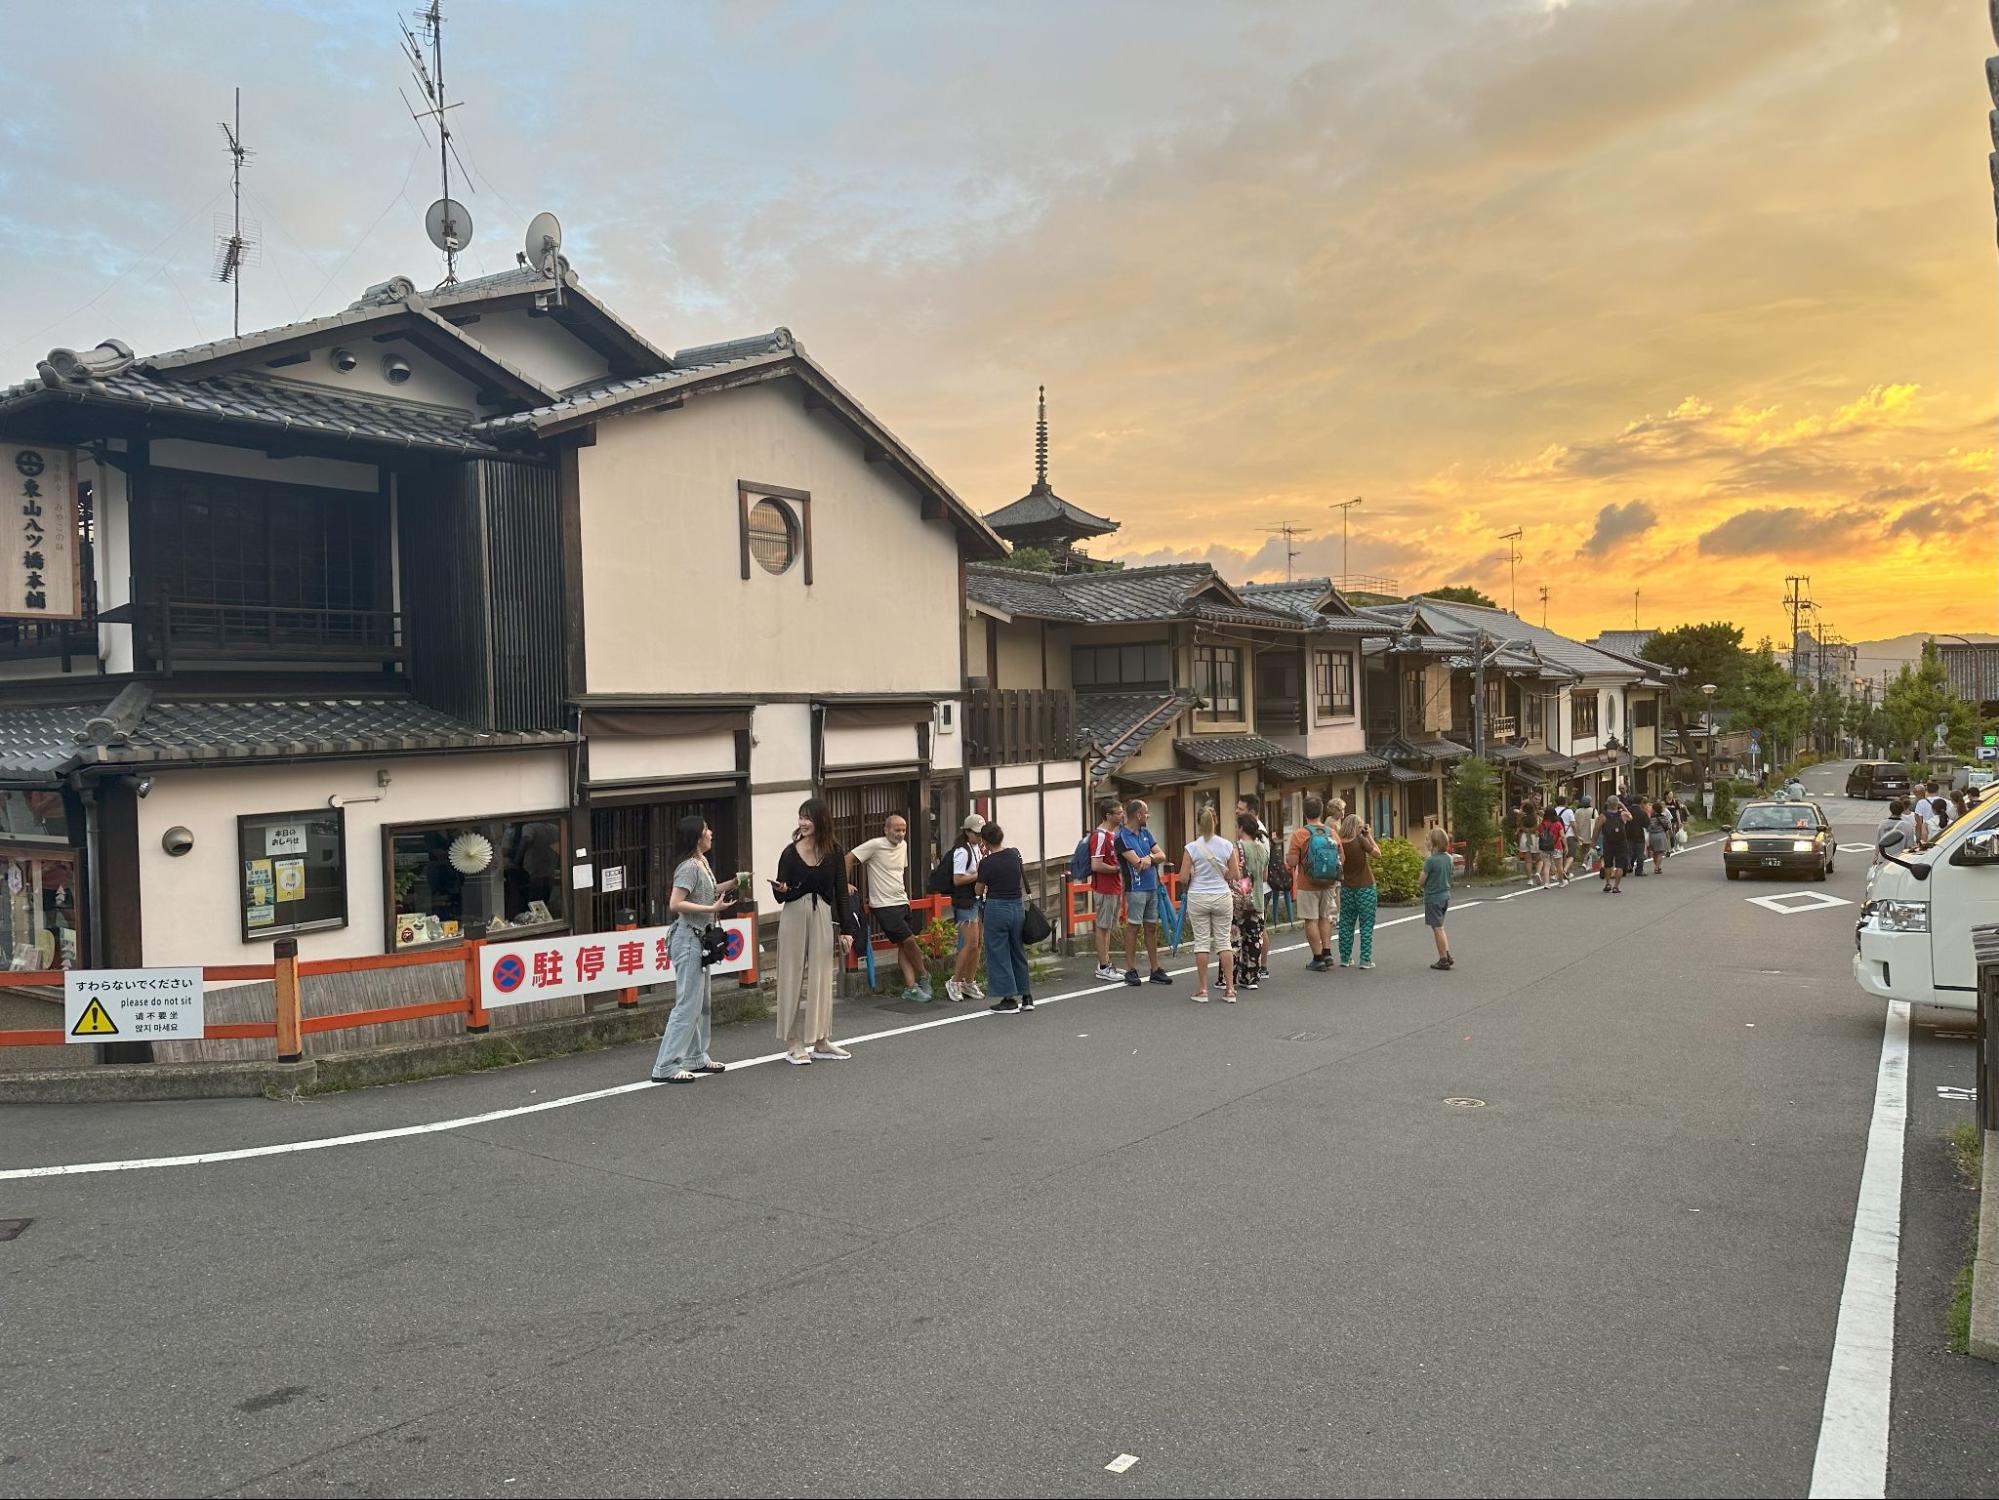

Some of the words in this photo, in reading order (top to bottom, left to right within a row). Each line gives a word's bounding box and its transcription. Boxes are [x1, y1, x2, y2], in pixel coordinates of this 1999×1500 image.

[1977, 748, 1996, 760] P
[76, 979, 193, 991] すわらないでください
[121, 997, 148, 1008] please
[151, 997, 162, 1006] do
[164, 996, 178, 1005] not
[181, 995, 192, 1005] sit
